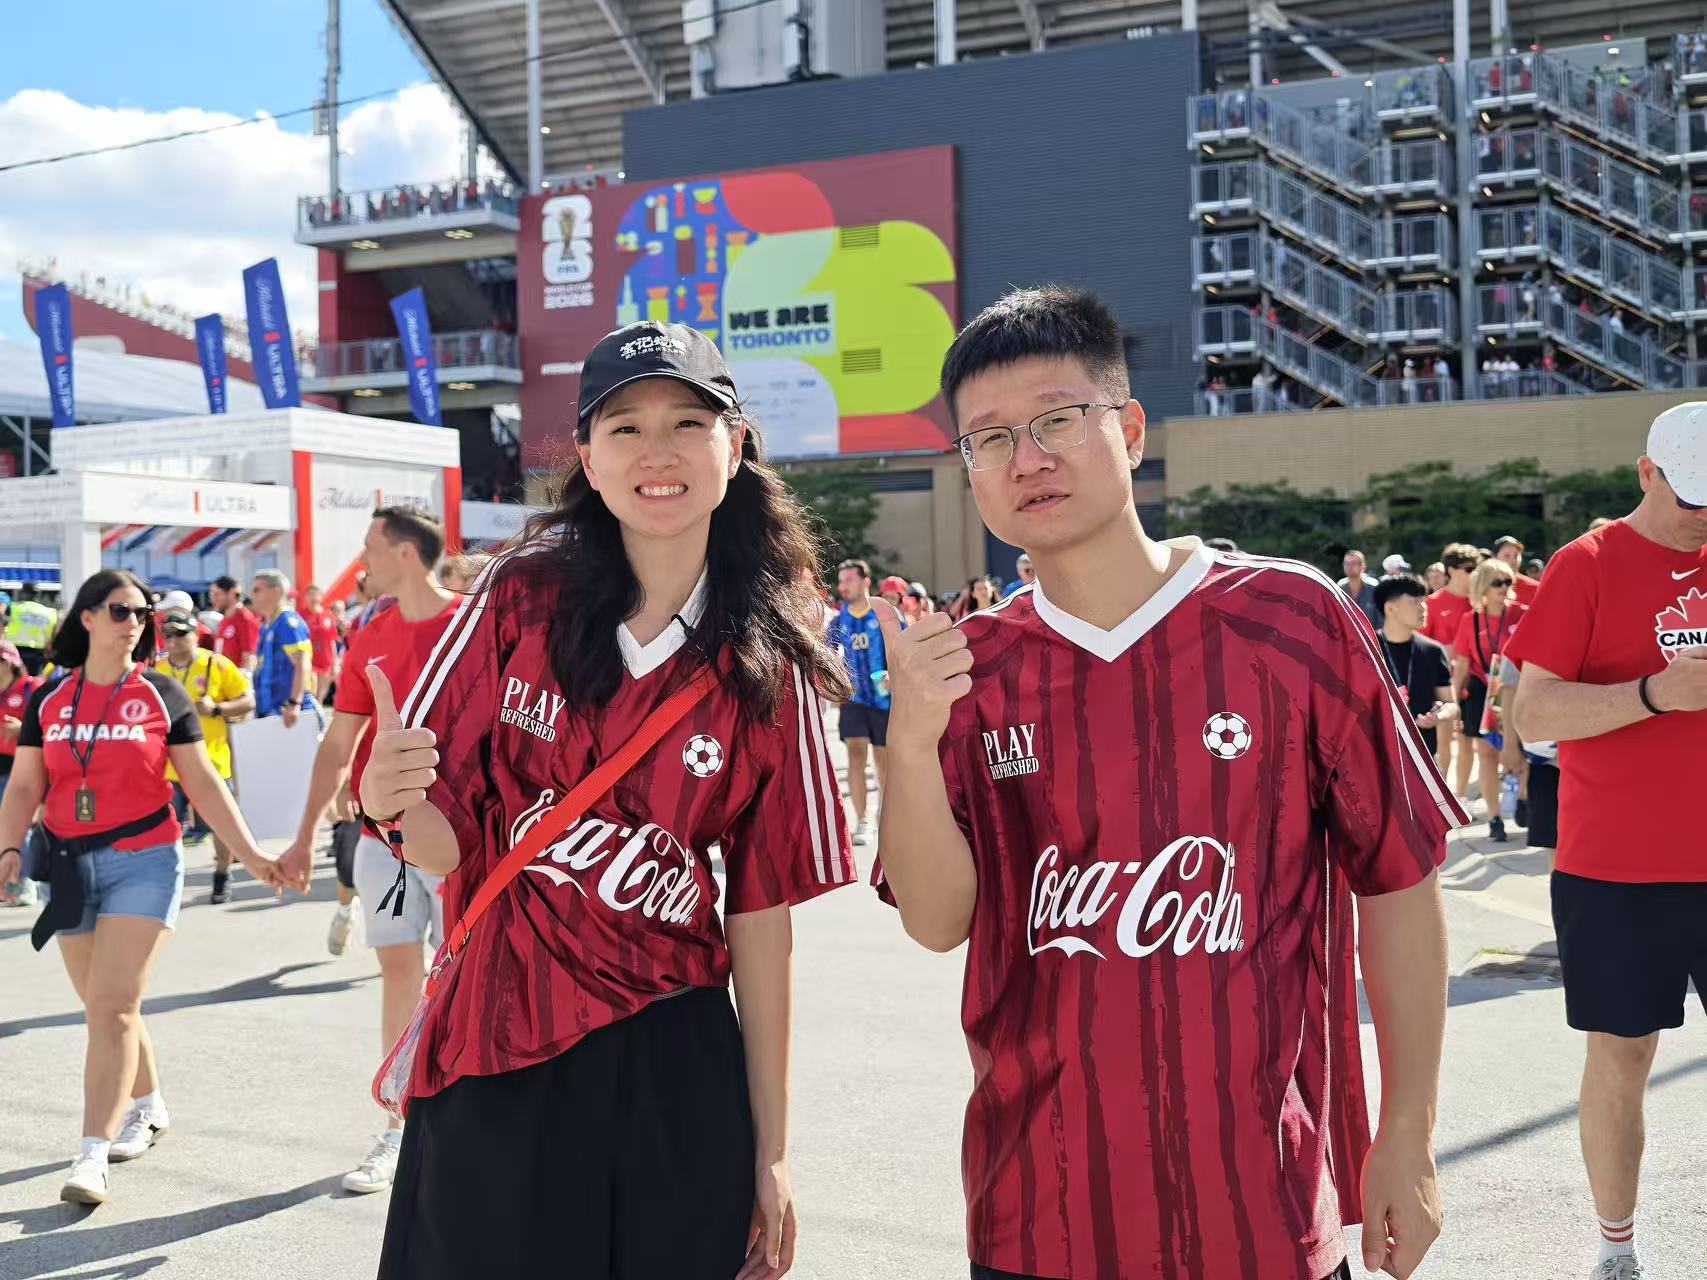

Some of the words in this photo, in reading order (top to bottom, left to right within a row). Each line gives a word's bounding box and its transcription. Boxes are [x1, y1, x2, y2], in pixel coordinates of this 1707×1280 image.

[730, 309, 769, 330] WE
[731, 328, 830, 350] TORONTO
[205, 495, 257, 513] ULTRA
[850, 632, 870, 650] 20
[502, 676, 566, 728] PLAY
[45, 723, 147, 742] CANADA
[500, 707, 556, 742] REFRESHED
[982, 723, 1035, 765] PLAY
[989, 757, 1039, 780] REFRESHED
[1027, 835, 1243, 960] Coca-Cola
